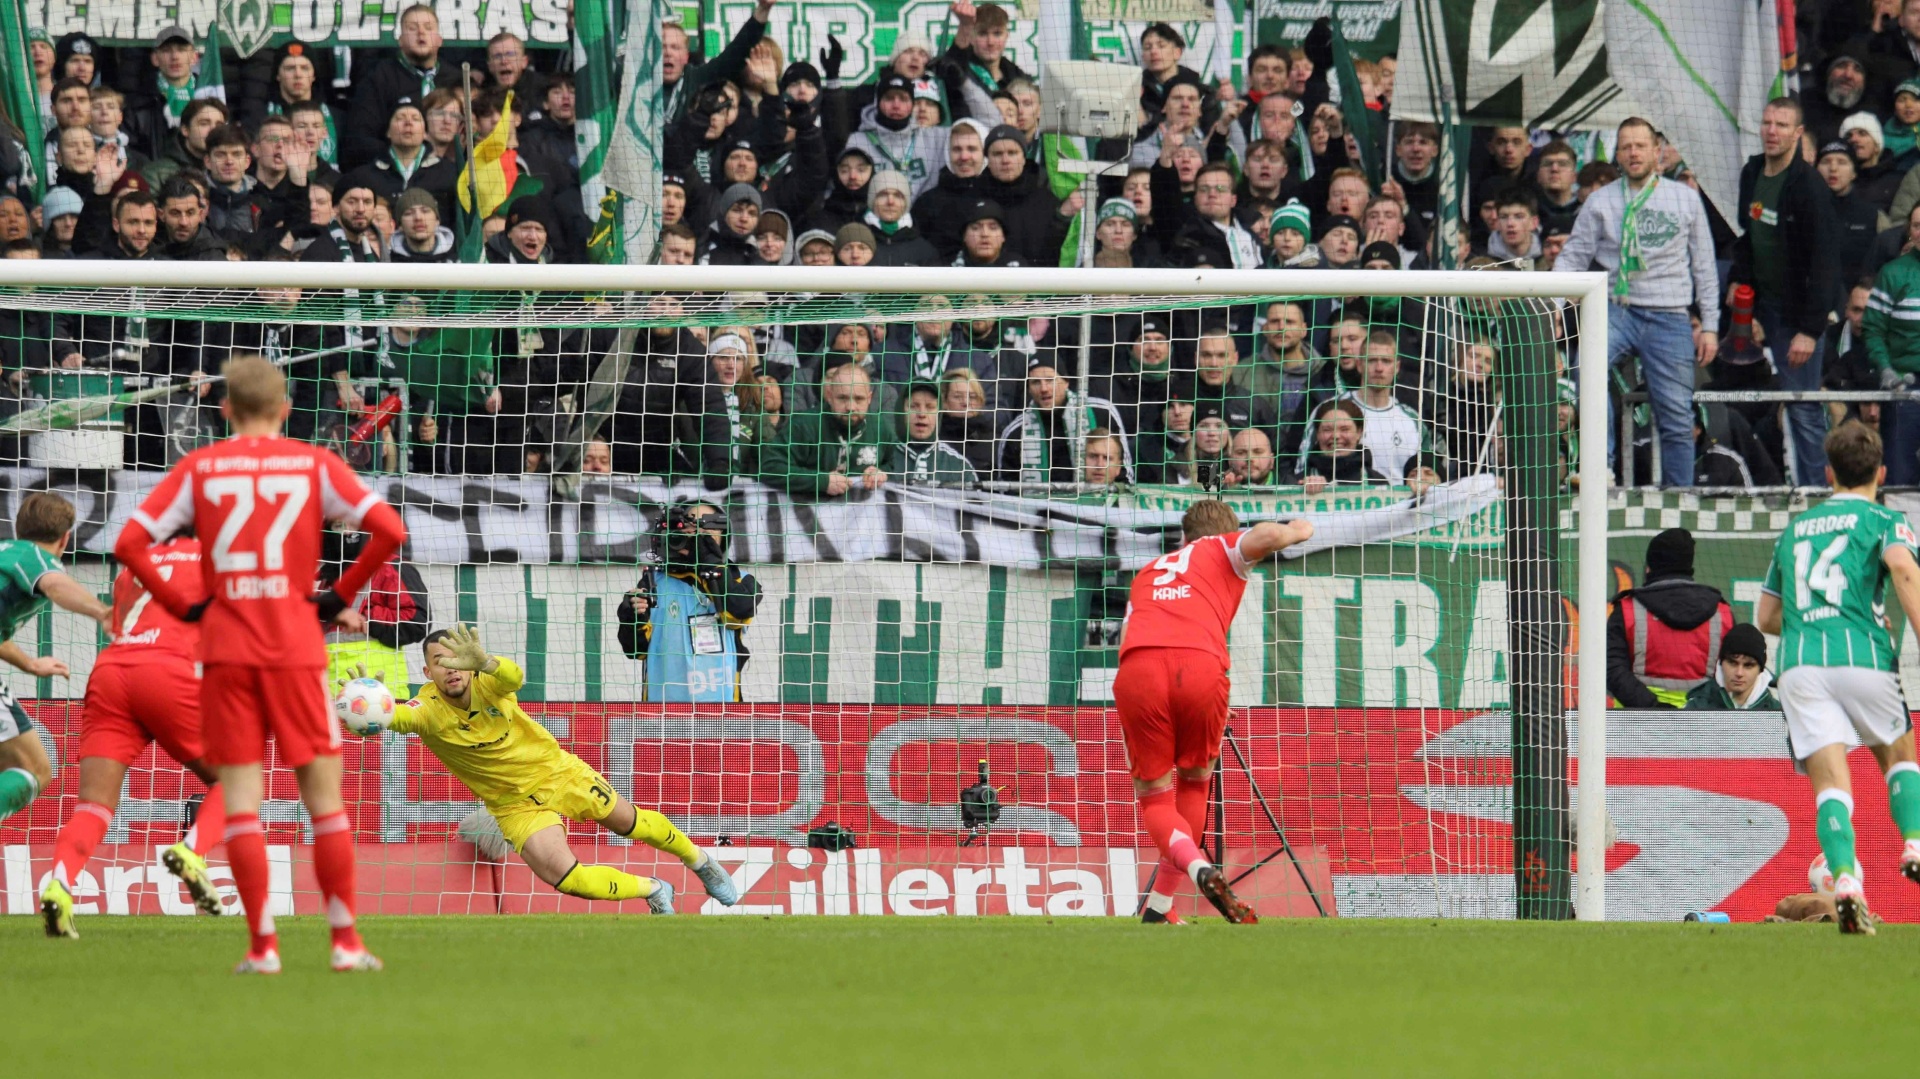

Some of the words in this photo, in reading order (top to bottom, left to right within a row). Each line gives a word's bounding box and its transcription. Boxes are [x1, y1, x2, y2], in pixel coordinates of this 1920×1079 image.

[203, 474, 310, 573] 27
[1794, 513, 1859, 538] WERDER
[1153, 544, 1195, 586] 9
[1793, 534, 1849, 611] 14
[1152, 584, 1192, 601] KANE
[590, 776, 613, 806] 30
[701, 846, 1140, 916] Zillertal
